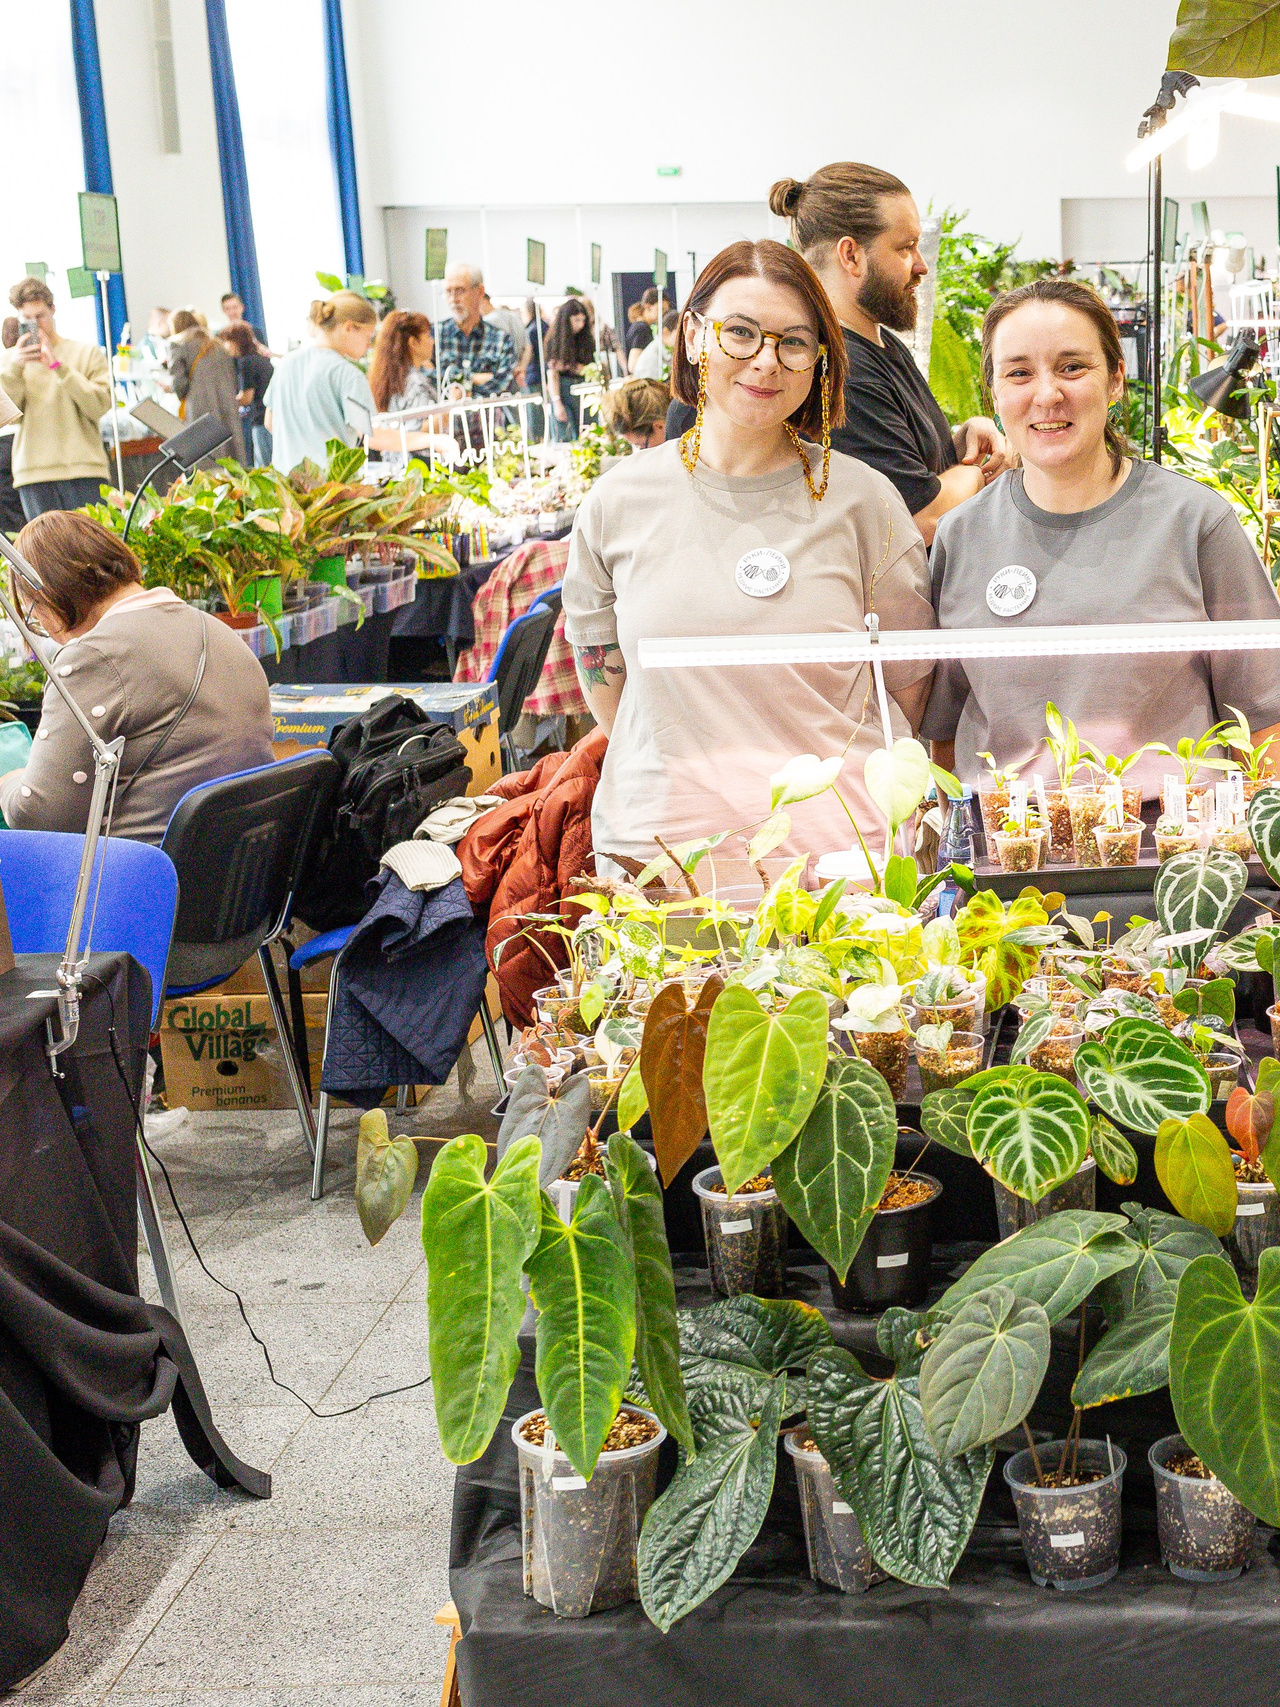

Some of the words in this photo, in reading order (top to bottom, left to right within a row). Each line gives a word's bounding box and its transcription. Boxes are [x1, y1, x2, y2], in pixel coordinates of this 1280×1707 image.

[272, 716, 327, 734] Premium
[191, 1085, 246, 1097] Premium
[216, 1093, 267, 1106] bananas
